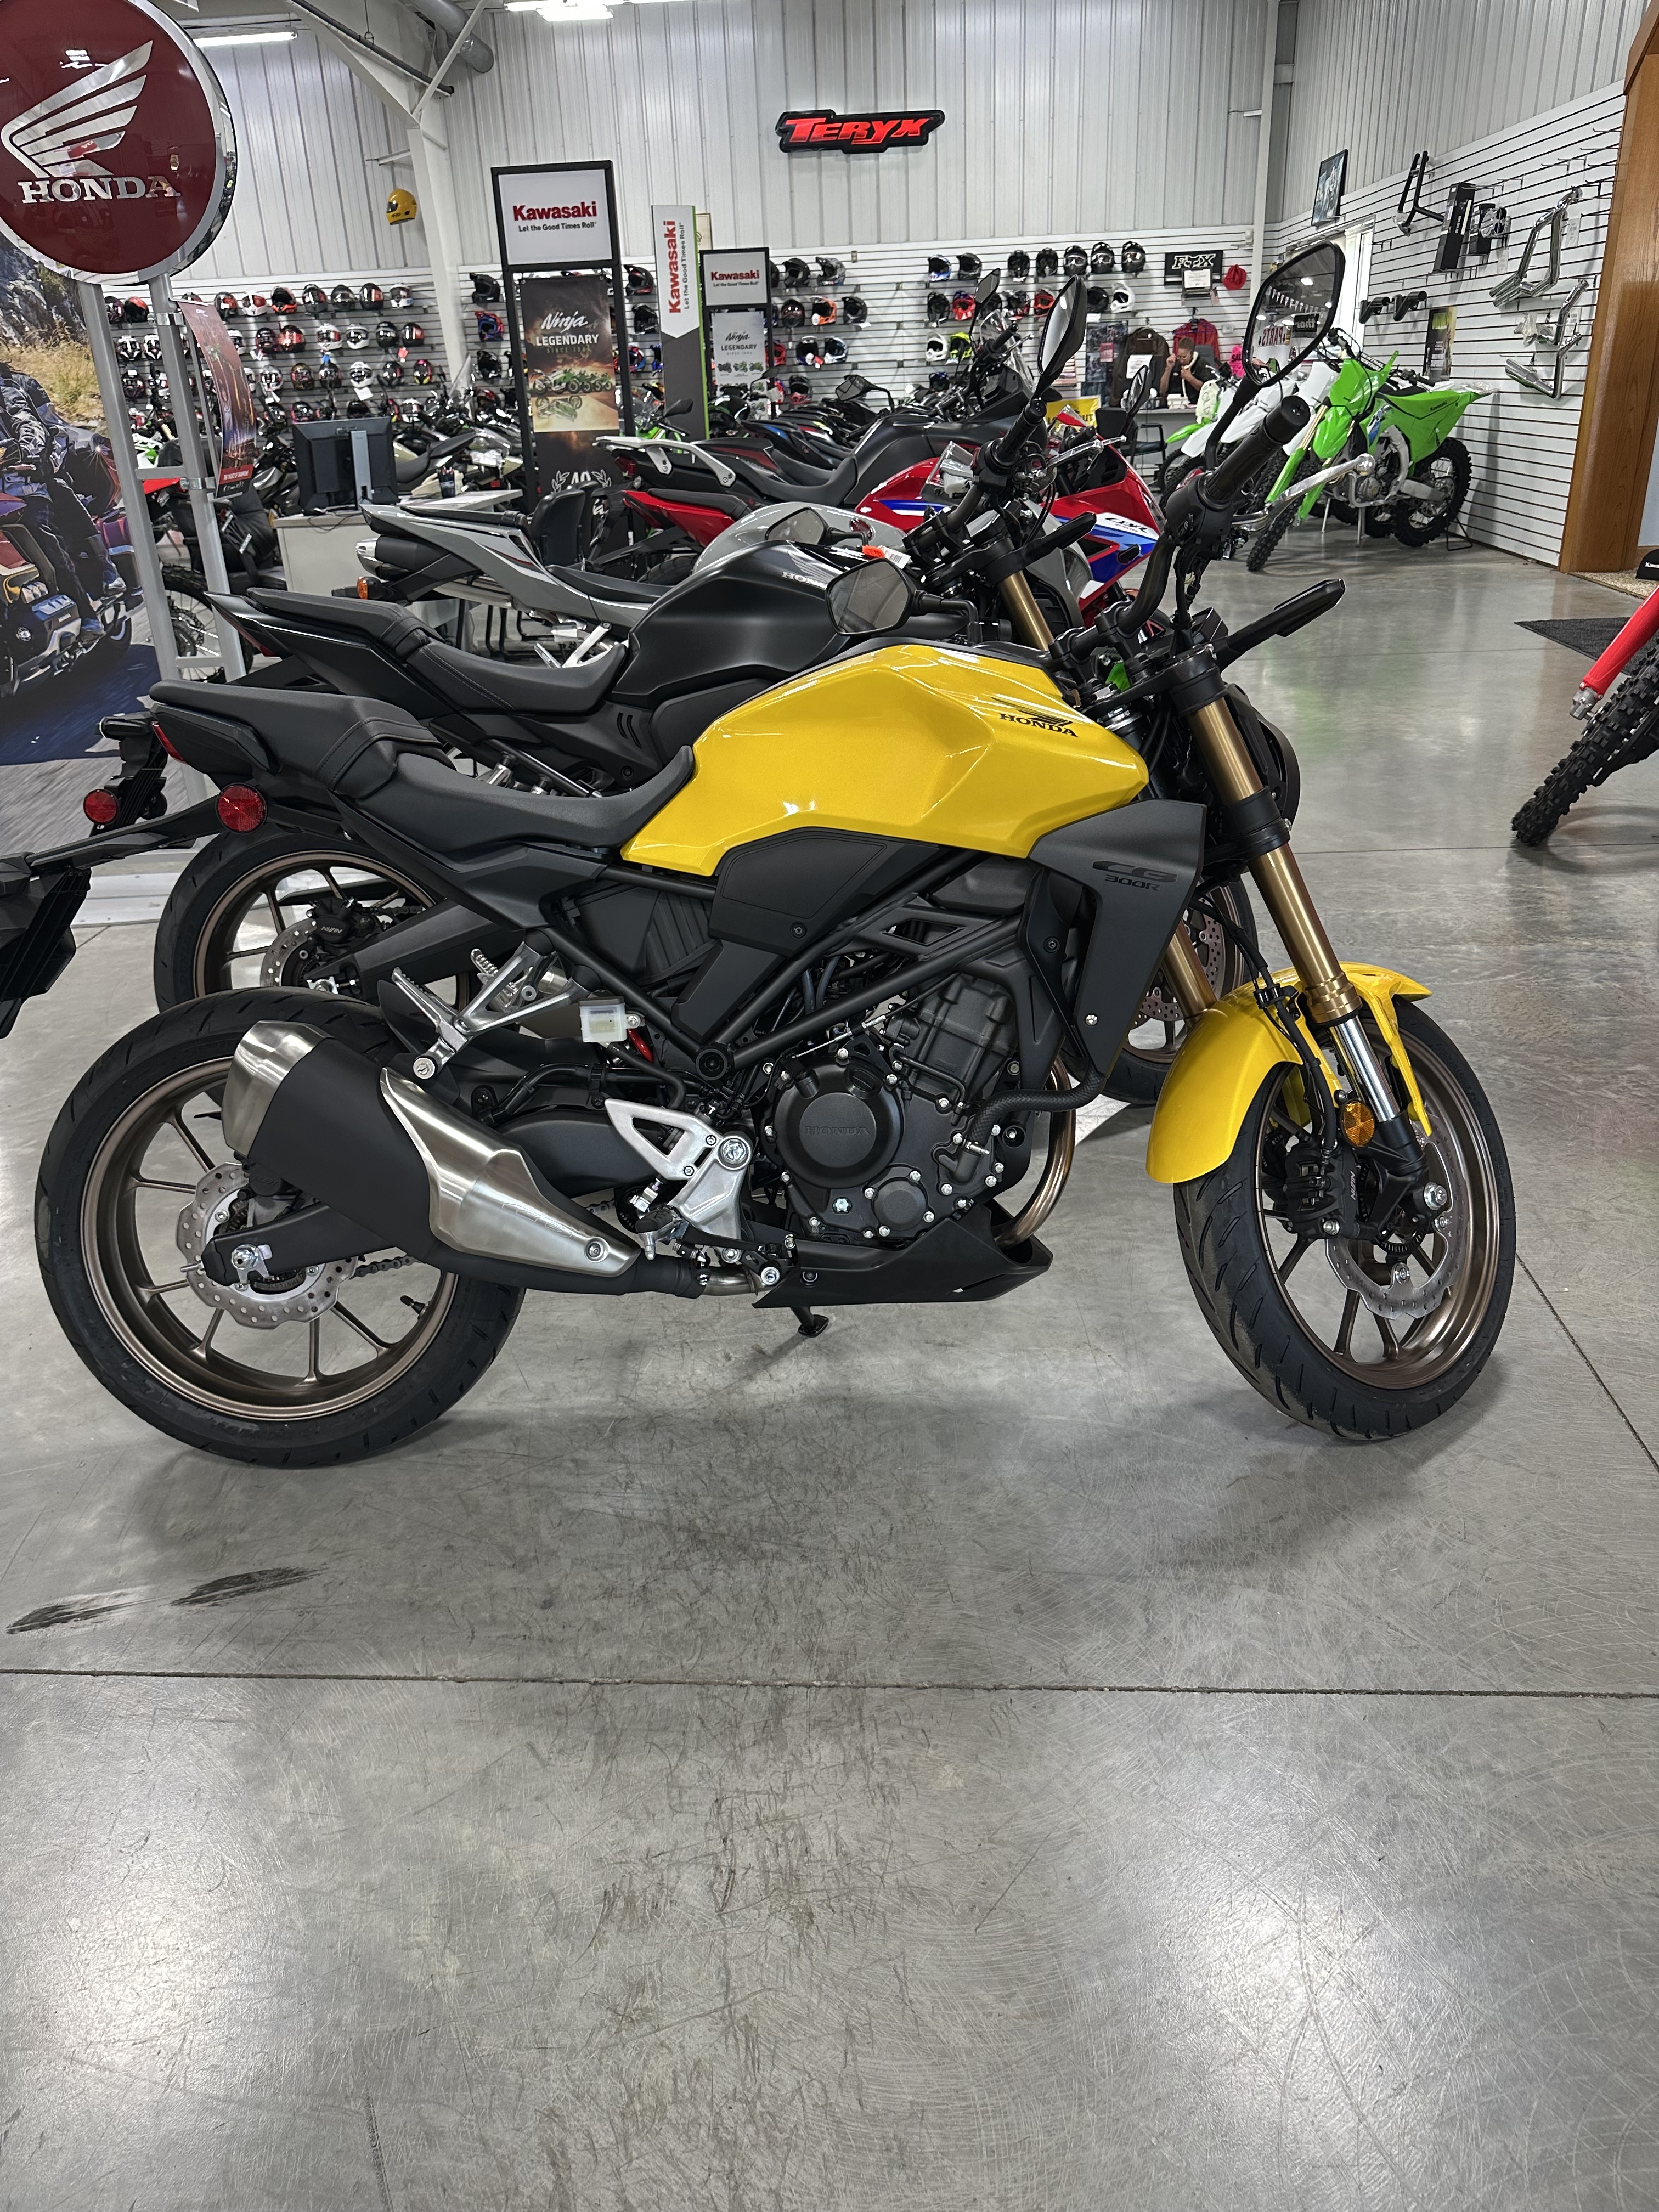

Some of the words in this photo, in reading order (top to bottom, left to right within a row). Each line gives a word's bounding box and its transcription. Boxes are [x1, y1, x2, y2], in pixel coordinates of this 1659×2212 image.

[785, 117, 930, 144] TERYX
[18, 175, 182, 204] HONDA
[513, 201, 597, 221] Kawasaki
[663, 221, 681, 313] Kawasaki
[710, 270, 760, 281] Kawasaki
[541, 311, 588, 334] Ninja
[535, 334, 599, 347] LEGENDARY
[725, 331, 751, 343] Ninja
[1231, 354, 1242, 363] SAL
[782, 571, 827, 590] HON
[998, 713, 1079, 738] HONDA
[1092, 861, 1178, 883] CB
[1104, 874, 1160, 891] 300R
[805, 1126, 870, 1135] HONDA
